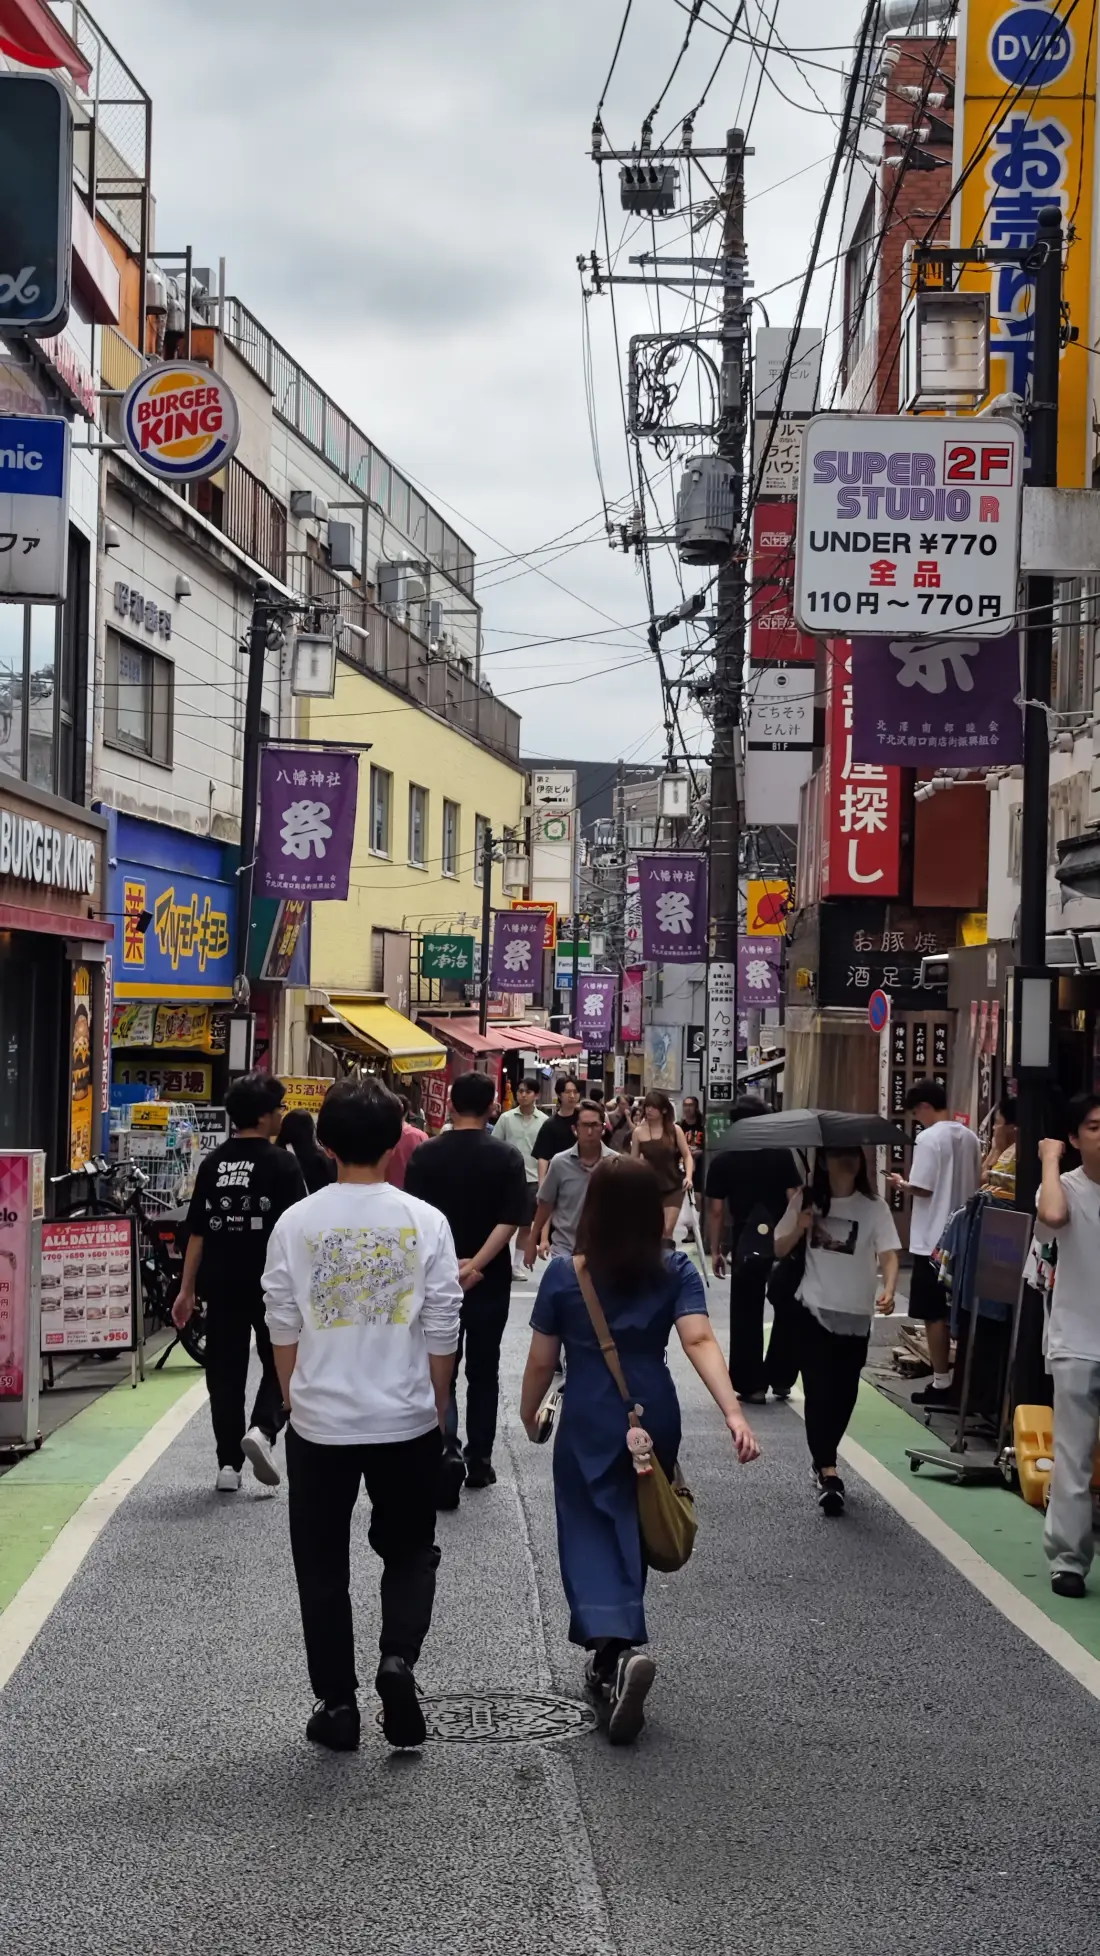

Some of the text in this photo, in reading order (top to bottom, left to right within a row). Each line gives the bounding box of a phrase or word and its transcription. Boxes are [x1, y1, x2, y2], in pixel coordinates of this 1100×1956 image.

[997, 35, 1068, 61] DVD
[138, 388, 219, 422] BURGER
[139, 411, 223, 450] KING
[813, 451, 936, 487] SUPER
[947, 447, 1010, 481] 2F
[837, 486, 1000, 522] STUDIO R
[809, 531, 997, 556] UNDER ¥770
[869, 559, 941, 588] 全品
[756, 706, 806, 719] ごちそう
[763, 725, 801, 736] とん汁
[276, 769, 342, 788] 八幡神社
[536, 785, 570, 794] 伊奈ビル
[280, 800, 333, 860] 祭
[0, 811, 96, 894] BURGER KING
[649, 870, 696, 882] 八幡神社
[655, 891, 694, 935] 祭
[503, 923, 538, 933] 八幡神社
[427, 943, 458, 953] キッチン
[853, 928, 938, 953] お豚焼
[432, 948, 468, 969] 南海
[503, 940, 532, 972] 祭
[746, 960, 772, 989] 祭
[583, 994, 604, 1016] 祭
[712, 1028, 730, 1037] アオ
[287, 1083, 327, 1096] 35酒場
[217, 1161, 255, 1174] SWIM
[216, 1174, 250, 1188] BEER
[44, 1235, 69, 1247] ALL
[70, 1233, 95, 1245] DAY
[95, 1230, 129, 1244] KING
